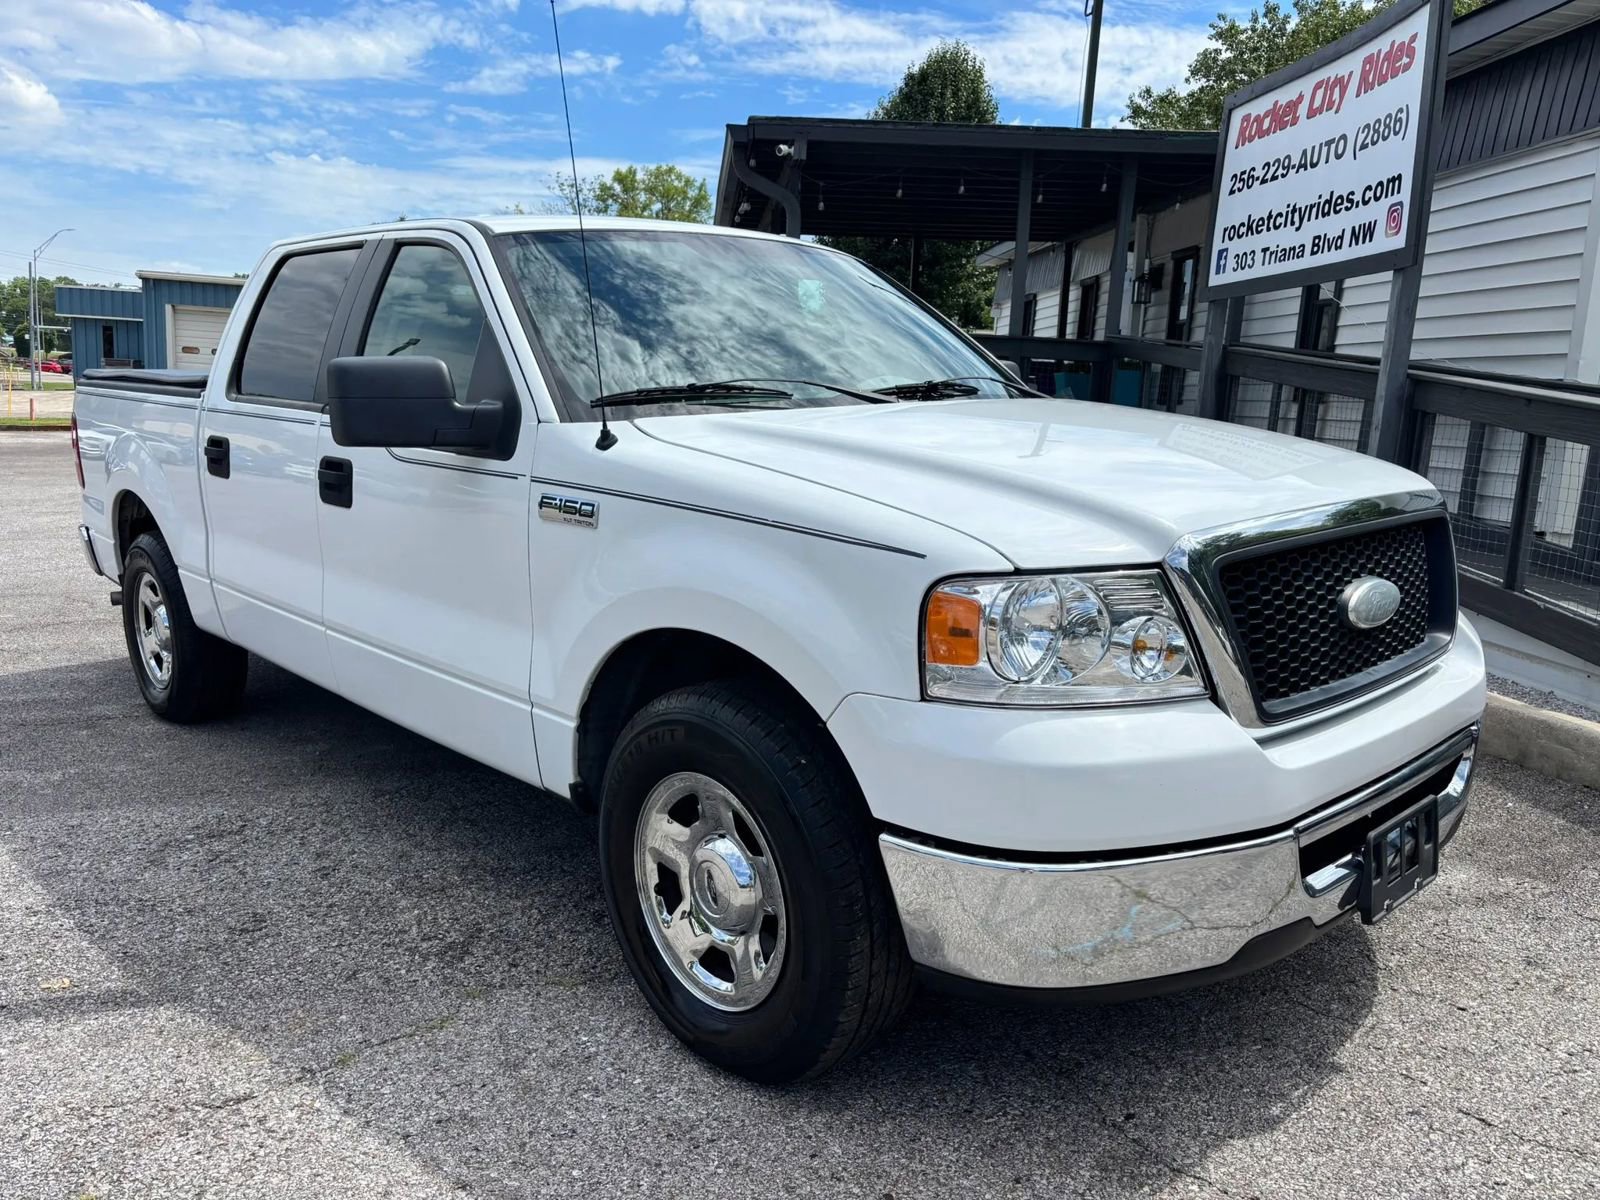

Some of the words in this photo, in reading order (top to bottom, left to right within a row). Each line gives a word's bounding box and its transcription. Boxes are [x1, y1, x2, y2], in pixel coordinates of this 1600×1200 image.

[1228, 133, 1348, 196] 256-229-AUTO
[1353, 104, 1409, 160] (2886)
[1235, 90, 1304, 149] Rocket
[1222, 172, 1402, 243] rocketcityrides.com
[1232, 249, 1256, 272] 303
[1261, 242, 1305, 266] Triana
[1310, 229, 1345, 256] Blvd
[1348, 219, 1377, 246] NW
